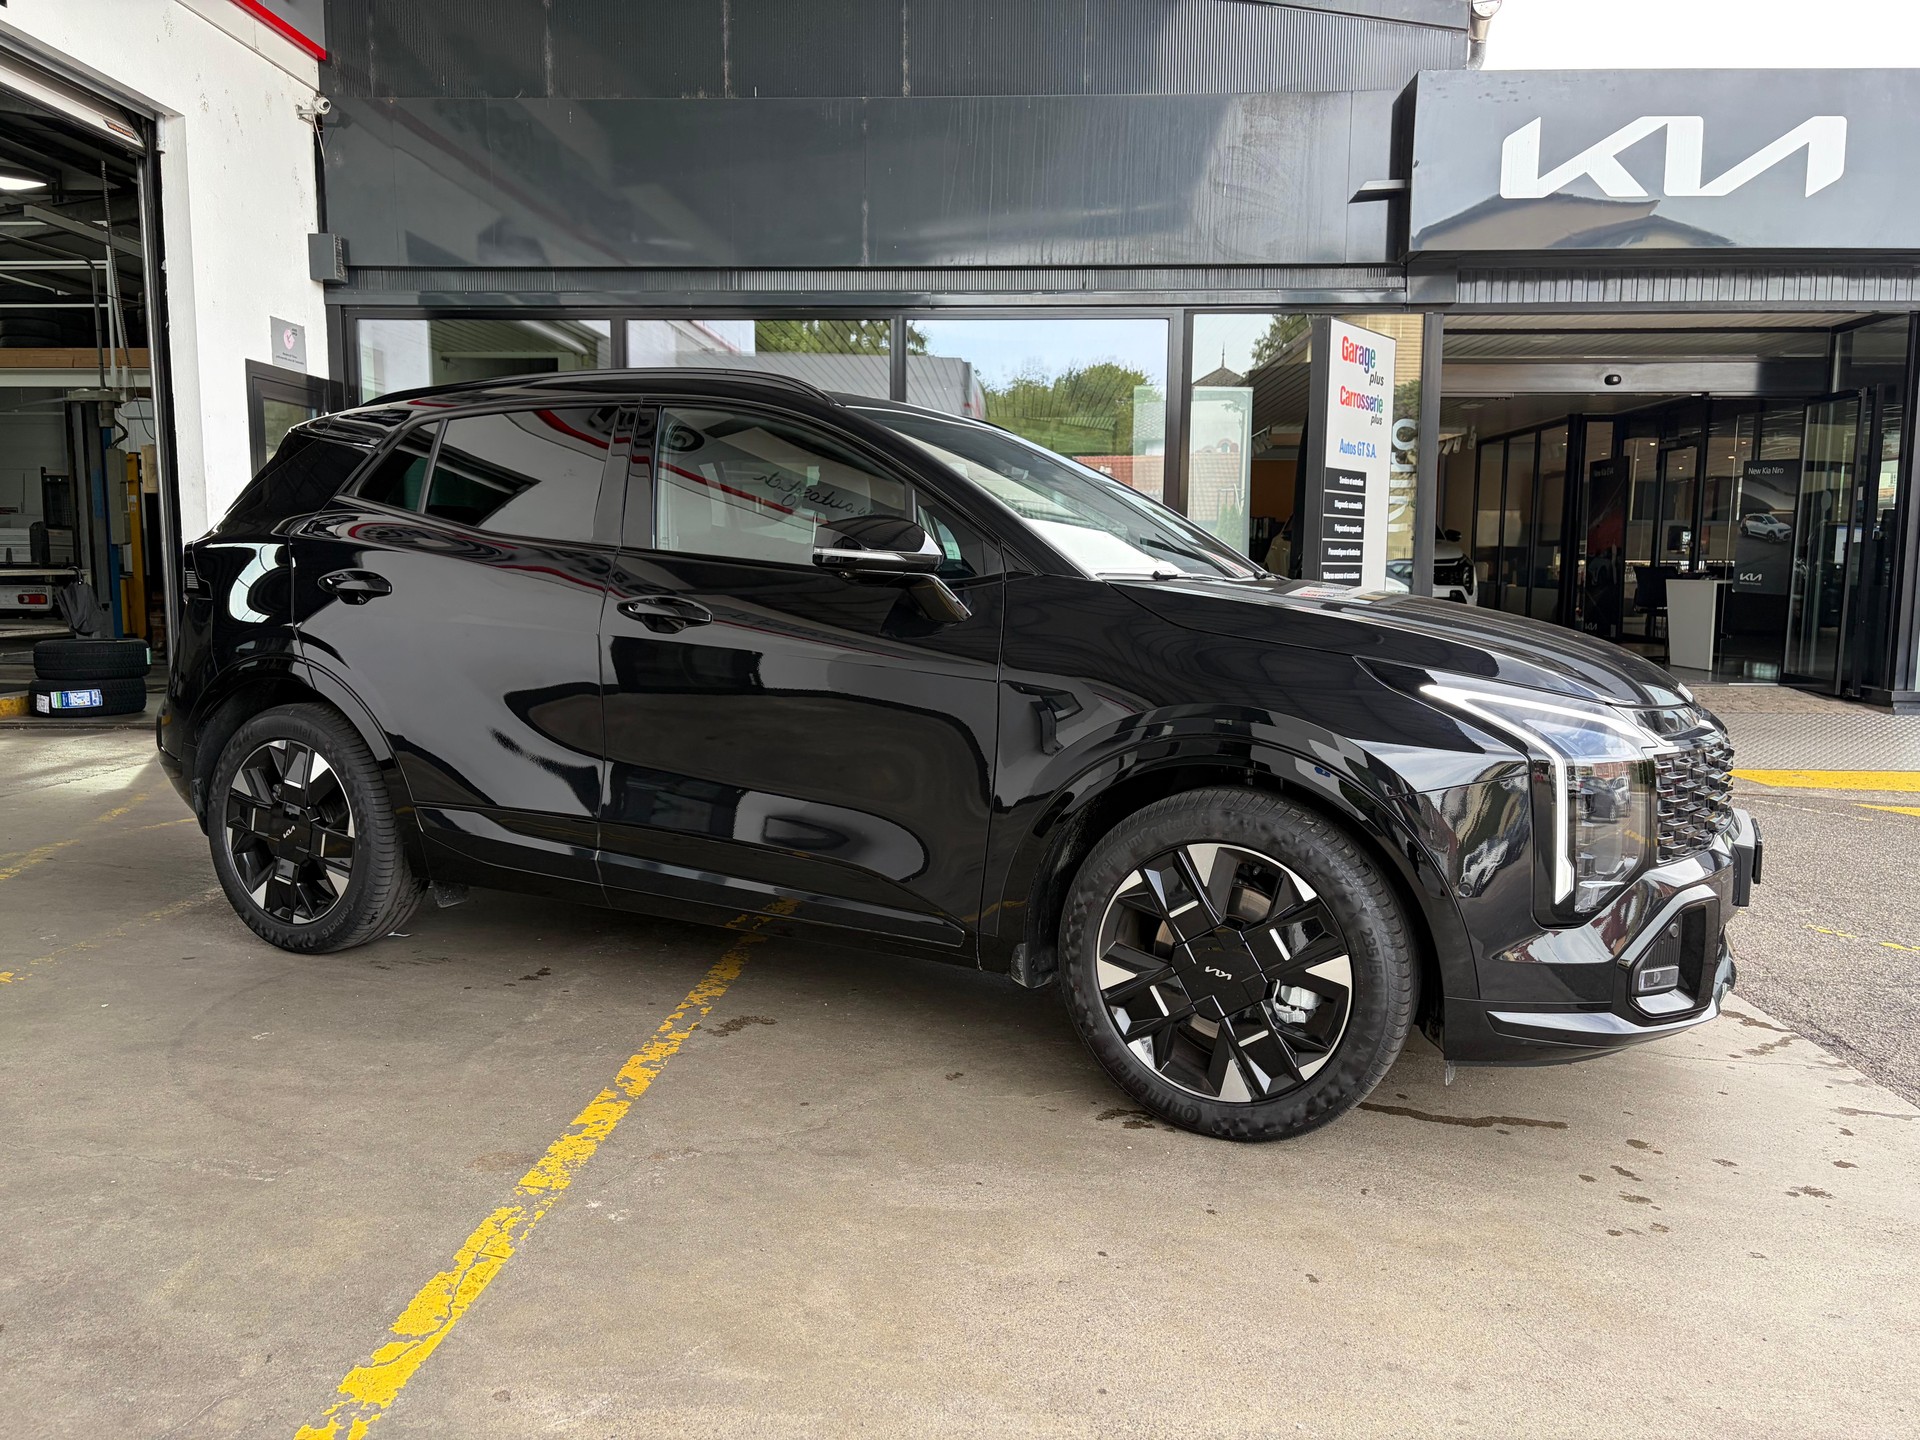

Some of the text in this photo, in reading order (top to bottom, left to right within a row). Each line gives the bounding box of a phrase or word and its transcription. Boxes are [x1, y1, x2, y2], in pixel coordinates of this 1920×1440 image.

[1500, 115, 1848, 198] KIA
[1342, 336, 1376, 373] Garage
[1369, 371, 1384, 386] plus
[1340, 386, 1383, 413] Carrosserie
[1371, 413, 1382, 425] plus
[1339, 438, 1356, 455] Autos
[1357, 441, 1365, 456] GT
[1748, 467, 1761, 475] New
[1762, 467, 1771, 475] Kia
